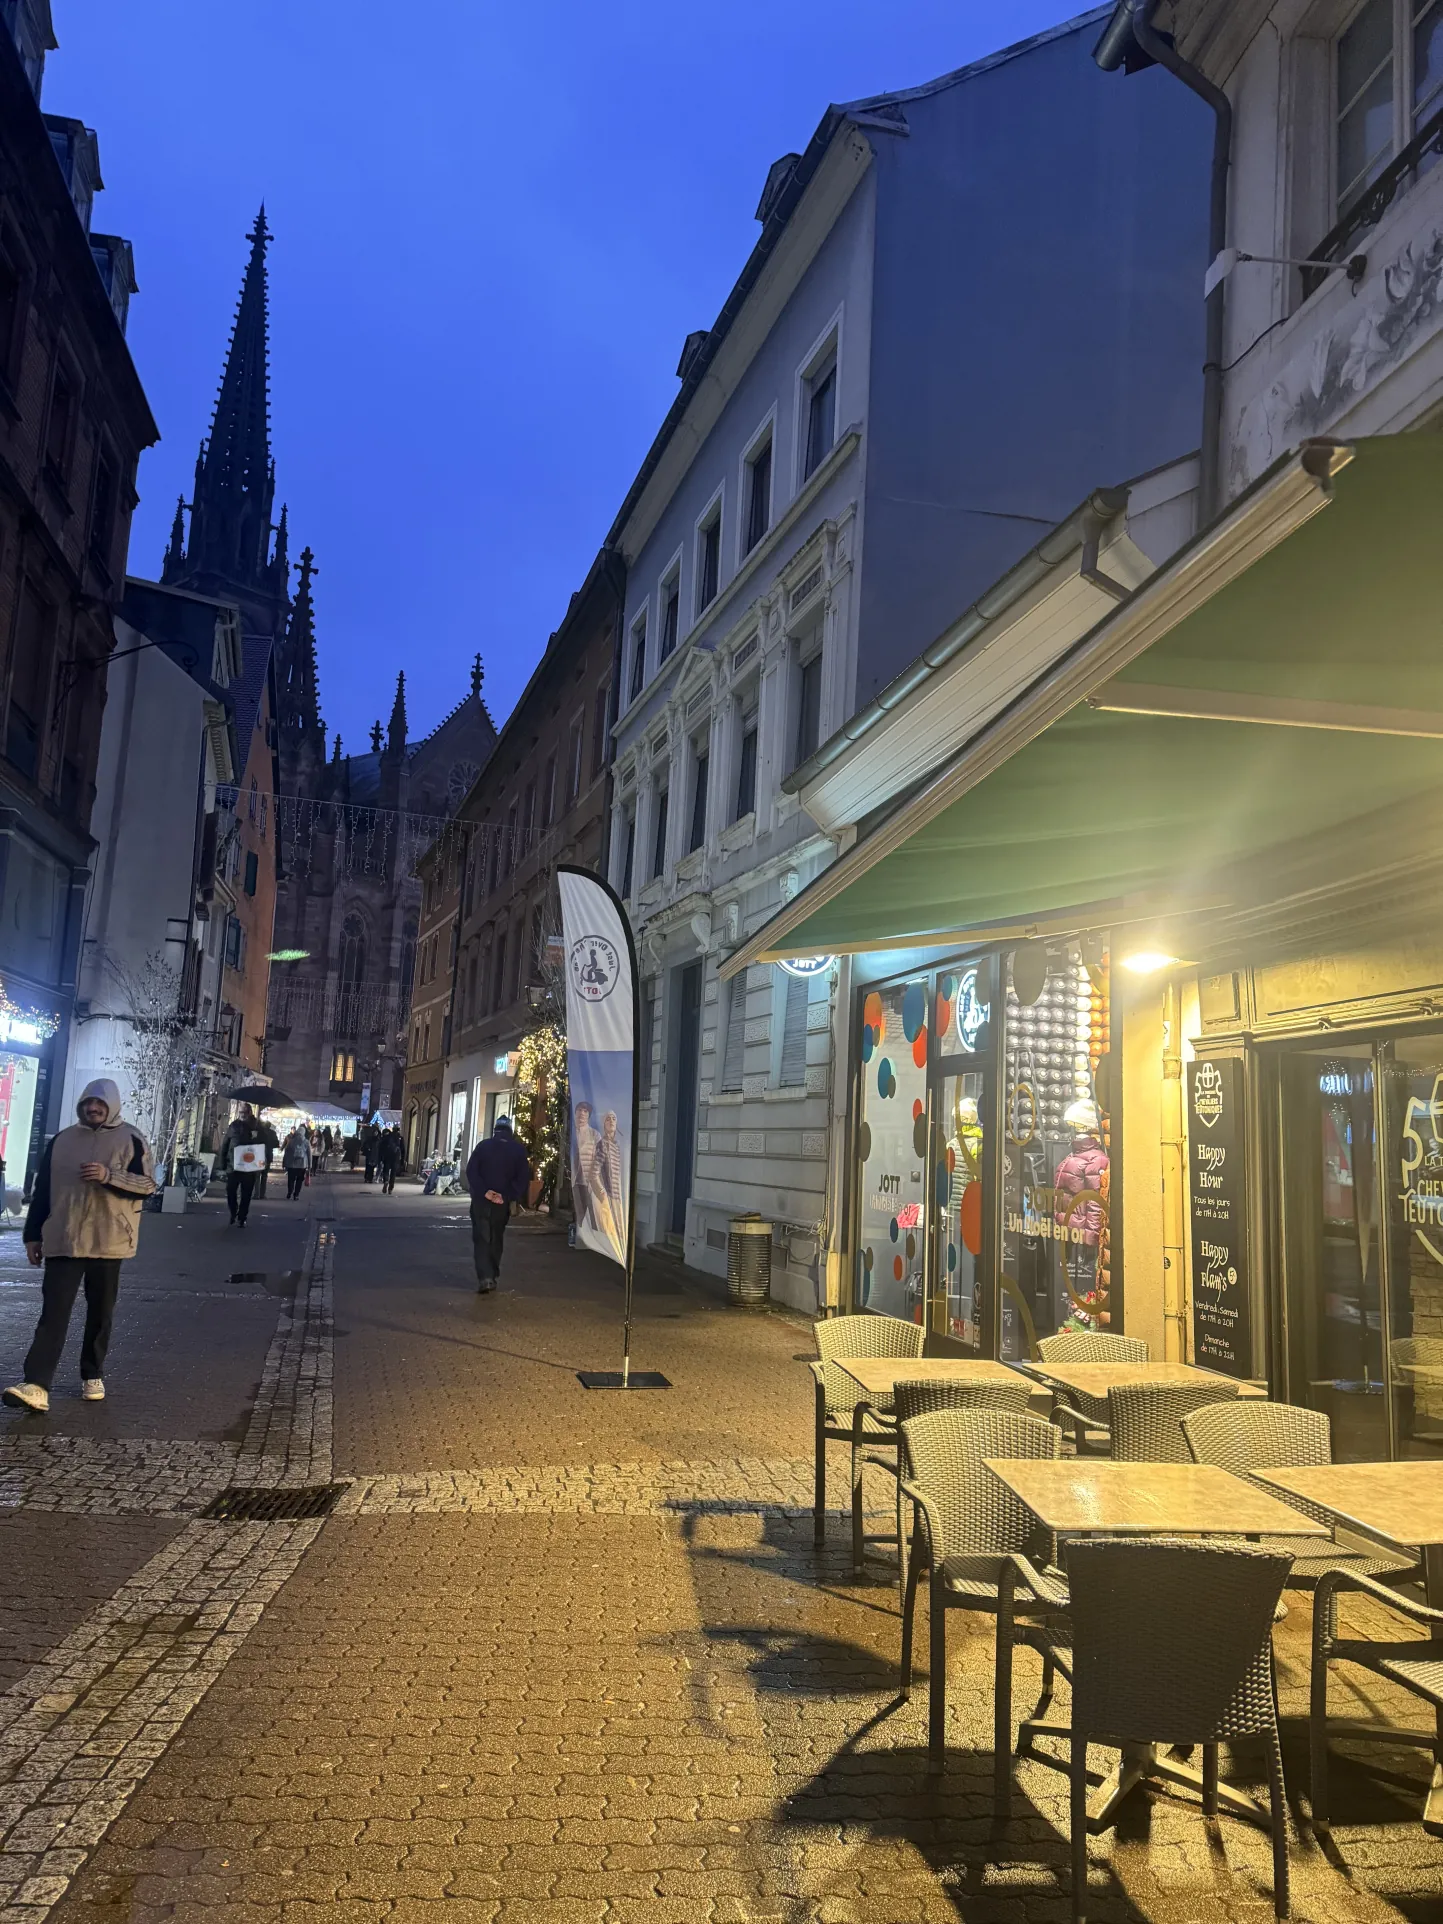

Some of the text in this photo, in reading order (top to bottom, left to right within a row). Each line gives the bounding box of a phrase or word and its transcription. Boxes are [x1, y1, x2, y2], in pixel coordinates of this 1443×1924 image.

[1197, 1144, 1226, 1171] Happy
[1424, 1155, 1437, 1167] LA
[879, 1173, 901, 1195] JOTT
[1199, 1171, 1224, 1189] Hour
[1207, 1196, 1216, 1206] les
[1215, 1196, 1231, 1210] jours
[1195, 1206, 1203, 1217] de
[1008, 1212, 1086, 1245] Un Noël en or
[1200, 1240, 1229, 1269] Happy
[1199, 1310, 1207, 1321] de
[1200, 1341, 1208, 1353] de
